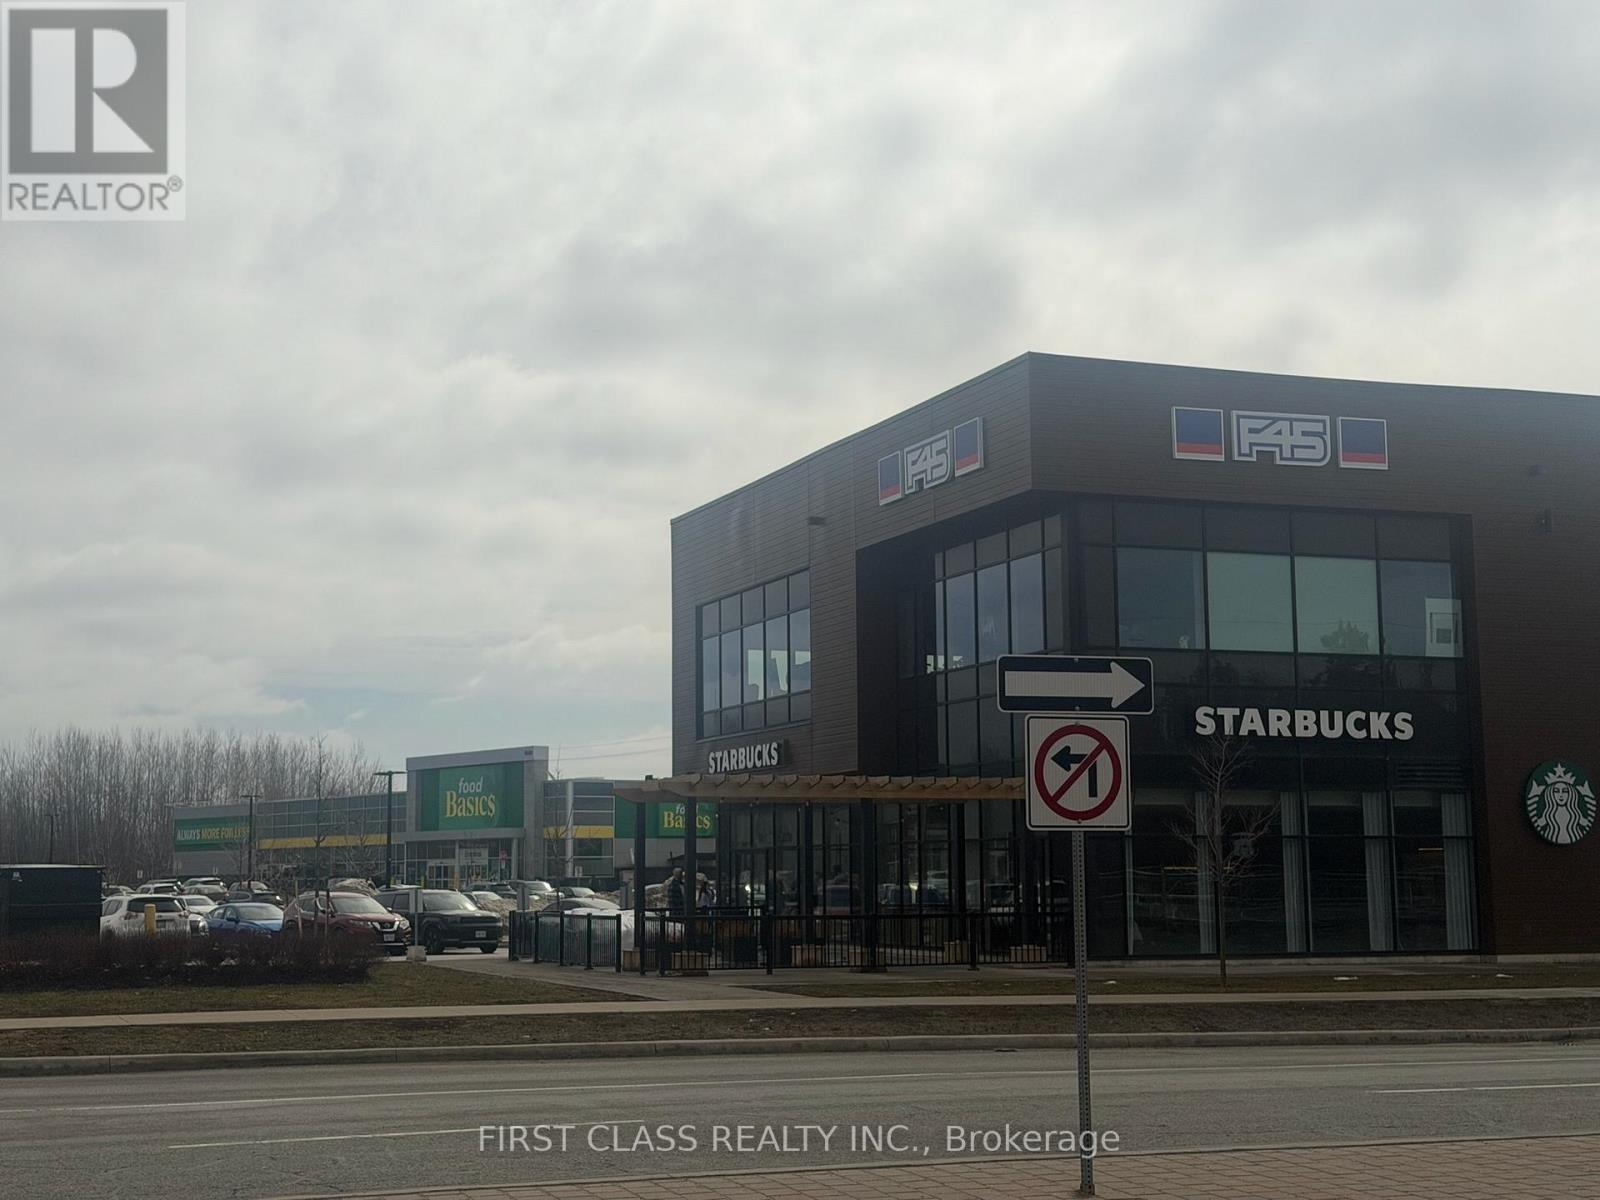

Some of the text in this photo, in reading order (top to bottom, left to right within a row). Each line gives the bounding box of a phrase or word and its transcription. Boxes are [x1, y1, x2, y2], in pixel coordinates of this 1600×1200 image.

[1233, 411, 1330, 465] F45
[905, 432, 950, 491] F45
[1194, 705, 1415, 741] STARBUCKS
[708, 741, 778, 774] STARBUCKS
[458, 776, 484, 795] food
[176, 828, 200, 841] ALWAYS
[201, 827, 220, 840] MORE
